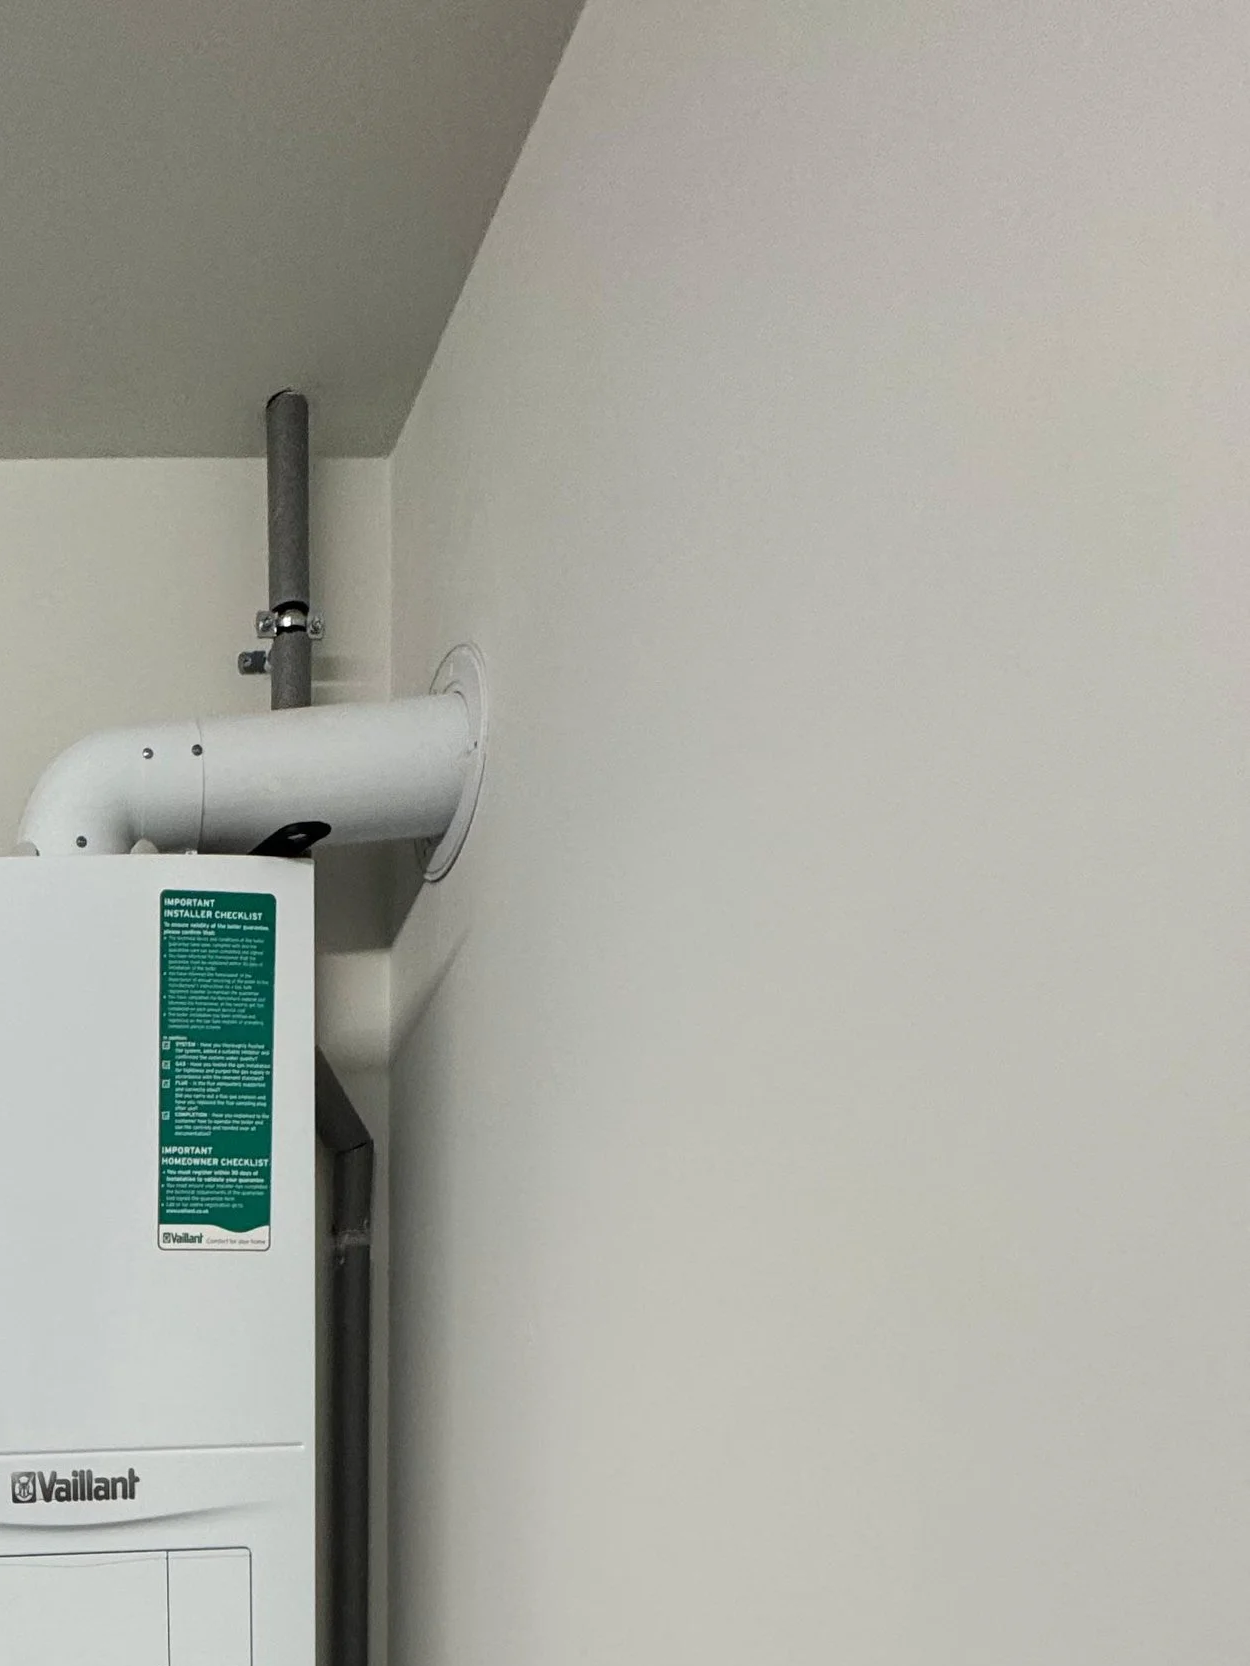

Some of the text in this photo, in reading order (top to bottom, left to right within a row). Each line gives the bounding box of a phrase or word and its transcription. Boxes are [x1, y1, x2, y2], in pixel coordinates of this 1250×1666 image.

[164, 898, 215, 907] IMPORTANT
[164, 910, 262, 920] INSTALLER CHECKLIST
[162, 1146, 213, 1154] IMPORTANT
[162, 1158, 269, 1167] HOMEOWNER CHECKLIST
[172, 1233, 203, 1244] Vaillant
[37, 1467, 140, 1503] Vaillant
